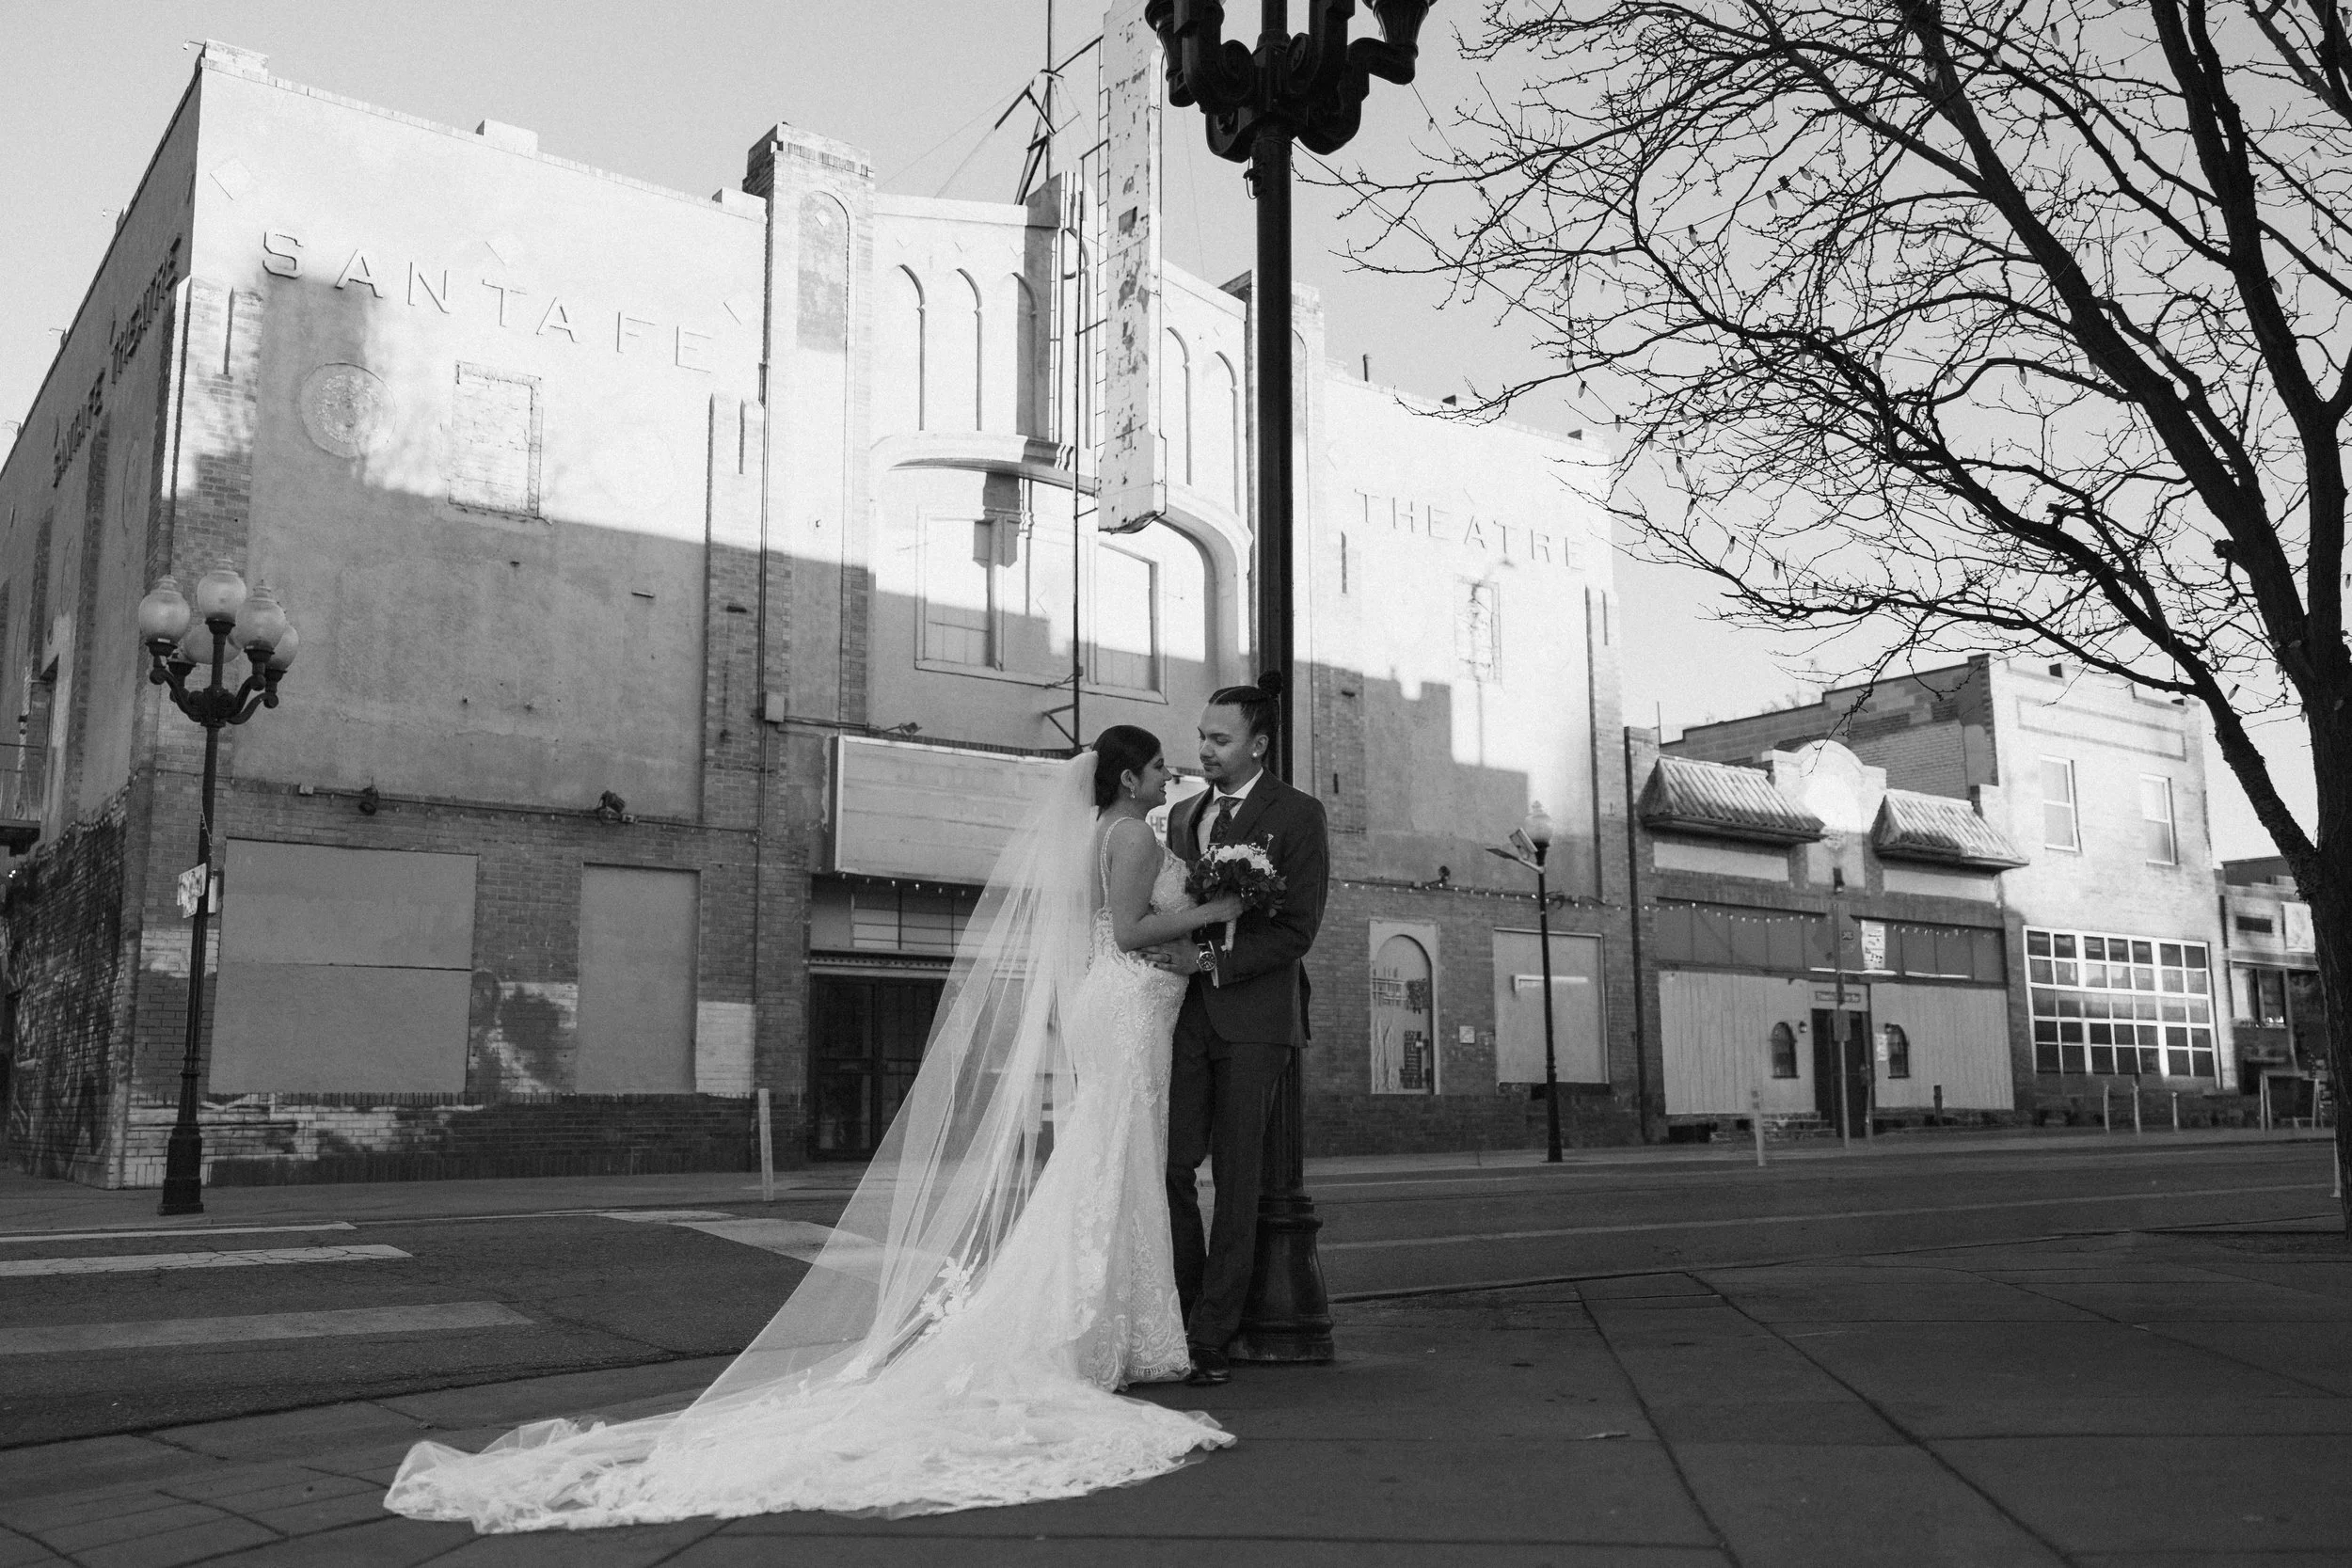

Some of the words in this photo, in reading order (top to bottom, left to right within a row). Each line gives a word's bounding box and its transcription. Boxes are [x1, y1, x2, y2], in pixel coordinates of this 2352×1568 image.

[262, 230, 580, 343] SANTA
[616, 311, 713, 373] FE
[1354, 487, 1587, 572] THEATRE
